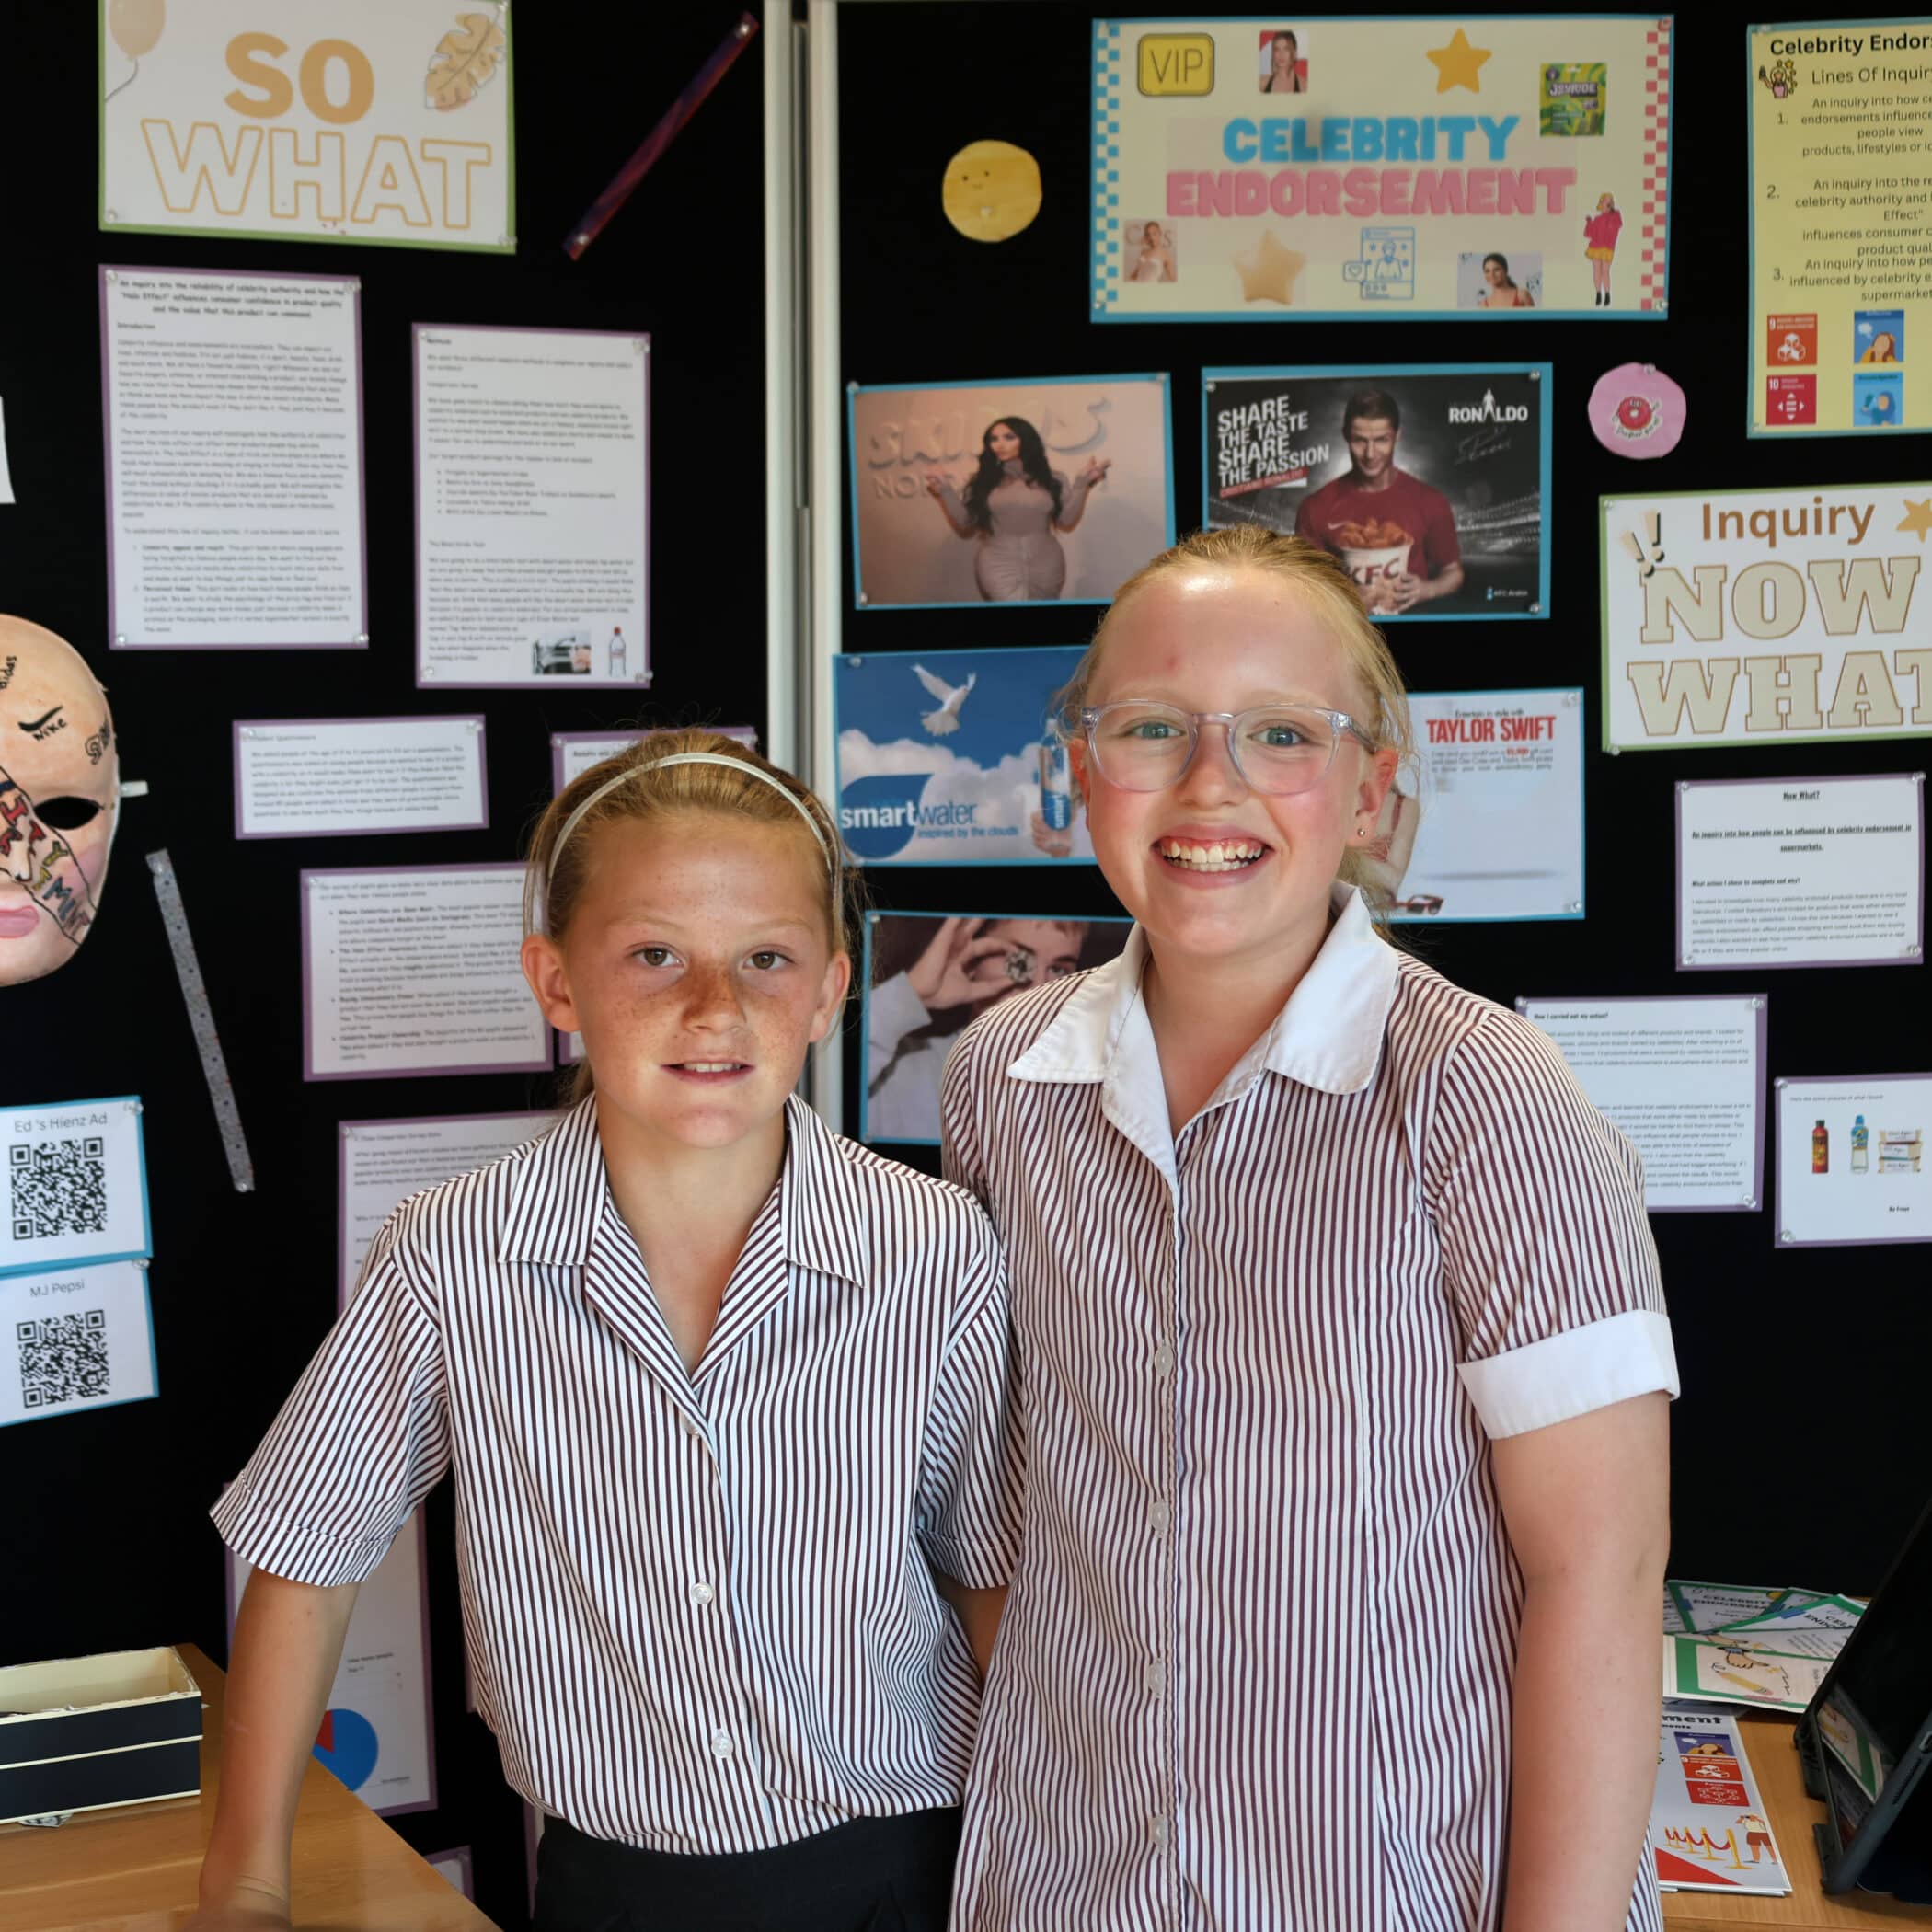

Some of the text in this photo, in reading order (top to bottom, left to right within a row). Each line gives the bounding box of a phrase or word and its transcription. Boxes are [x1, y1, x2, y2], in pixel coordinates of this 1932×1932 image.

[1770, 37, 1864, 57] Celebrity
[1149, 48, 1204, 84] VIP
[1811, 69, 1854, 85] Lines
[1858, 66, 1878, 83] Of
[224, 31, 374, 125] SO
[1812, 98, 1827, 109] An
[1830, 97, 1869, 110] inquiry
[1871, 95, 1893, 107] into
[1897, 94, 1919, 105] how
[1777, 113, 1788, 125] 1.
[1801, 111, 1880, 124] endorsements
[1223, 114, 1521, 164] CELEBRITY
[1857, 126, 1923, 141] people view
[1802, 141, 1921, 157] products, lifestyles or
[141, 118, 492, 230] WHAT
[1813, 179, 1829, 190] An
[1832, 178, 1872, 191] inquiry
[1875, 176, 1898, 188] into
[1901, 176, 1920, 187] the
[1166, 167, 1578, 219] ENDORSEMENT
[1767, 185, 1780, 199] 2.
[1795, 191, 1926, 209] celebrity authority and
[1883, 208, 1924, 221] Effect"
[1802, 227, 1923, 241] influences consumer
[1857, 243, 1903, 258] product
[1805, 256, 1916, 271] An inquiry into how
[1773, 269, 1784, 281] 3.
[1789, 275, 1850, 287] influenced
[1854, 273, 1868, 287] by
[1870, 271, 1921, 285] celebrity
[1768, 378, 1779, 391] 10
[1217, 395, 1290, 433] SHARE
[1449, 396, 1529, 424] RONALDO
[1218, 410, 1308, 450] THE TASTE
[1218, 433, 1291, 471] SHARE
[1218, 443, 1330, 489] THE PASSION
[1702, 495, 1876, 549] Inquiry
[1639, 556, 1922, 645] NOW
[32, 718, 68, 742] Nike
[1425, 714, 1557, 744] TAYLOR SWIFT
[14, 1119, 32, 1133] Ed
[90, 1111, 108, 1126] Ad
[30, 1277, 86, 1297] MJ Pepsi
